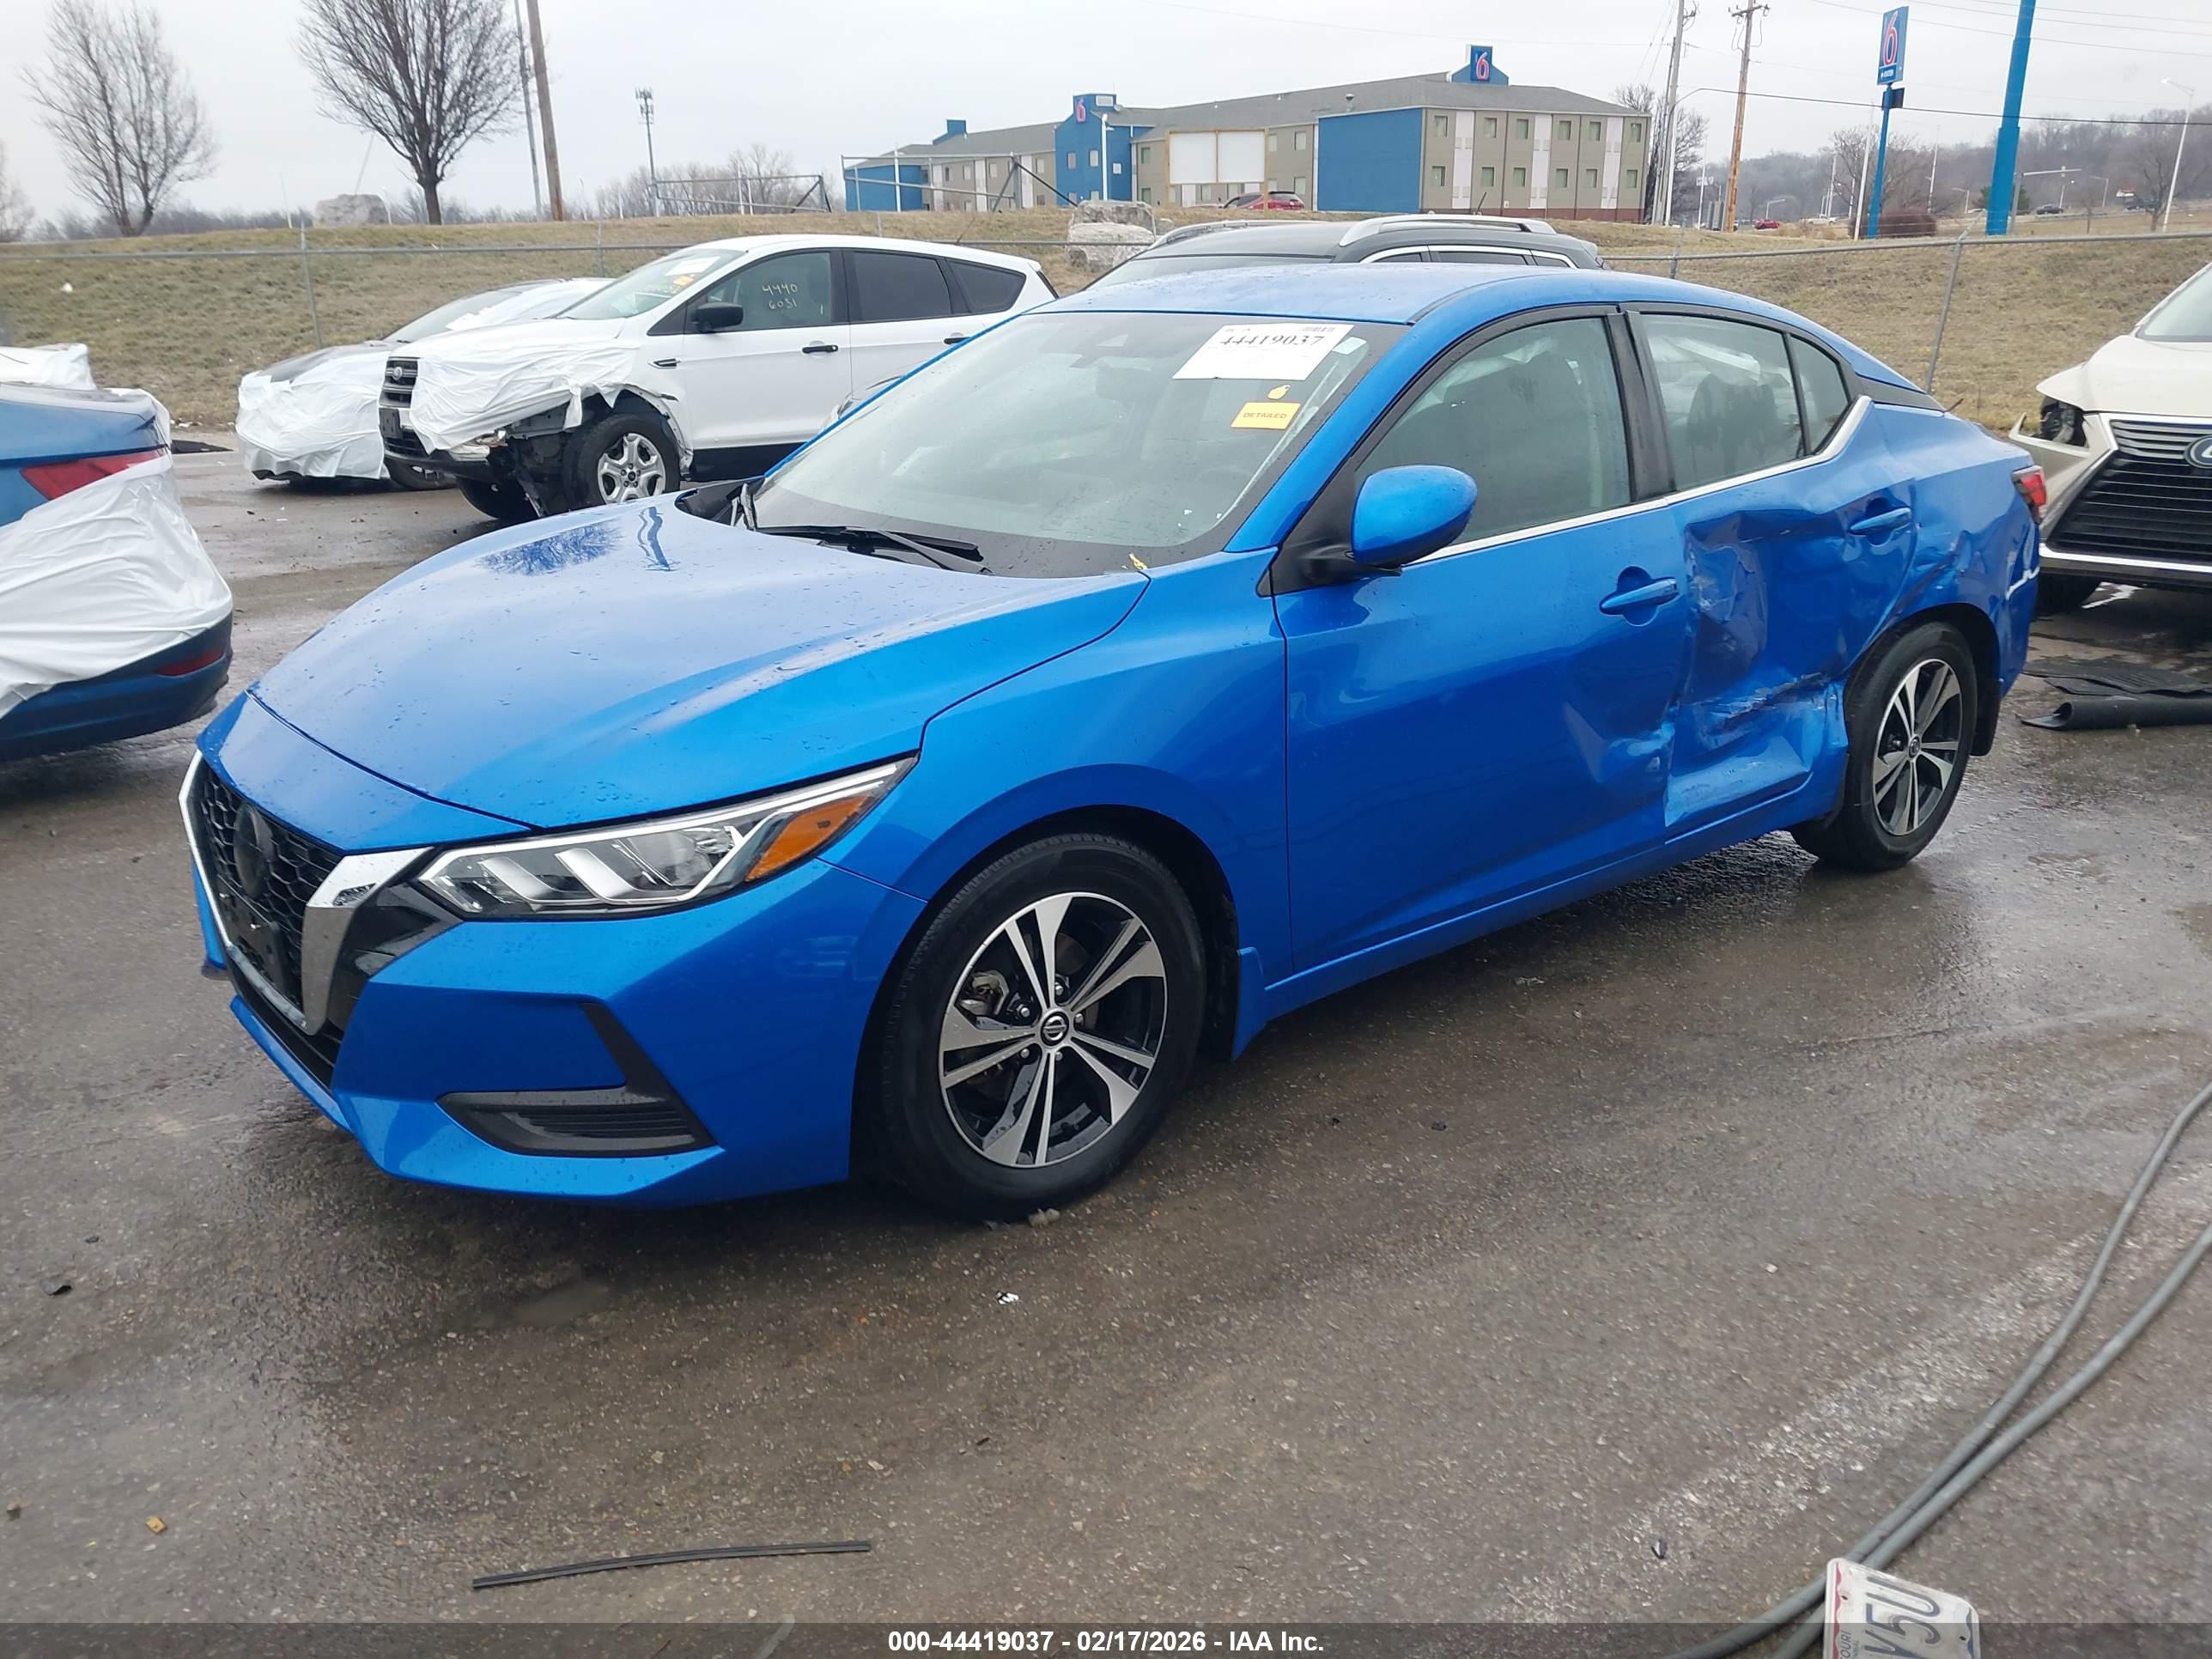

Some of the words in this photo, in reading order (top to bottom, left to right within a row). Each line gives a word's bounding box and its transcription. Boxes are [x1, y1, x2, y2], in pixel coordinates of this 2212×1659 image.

[1883, 10, 1898, 66] 6
[1475, 52, 1490, 80] 6
[762, 283, 798, 296] 4440
[1219, 335, 1325, 345] 44419037
